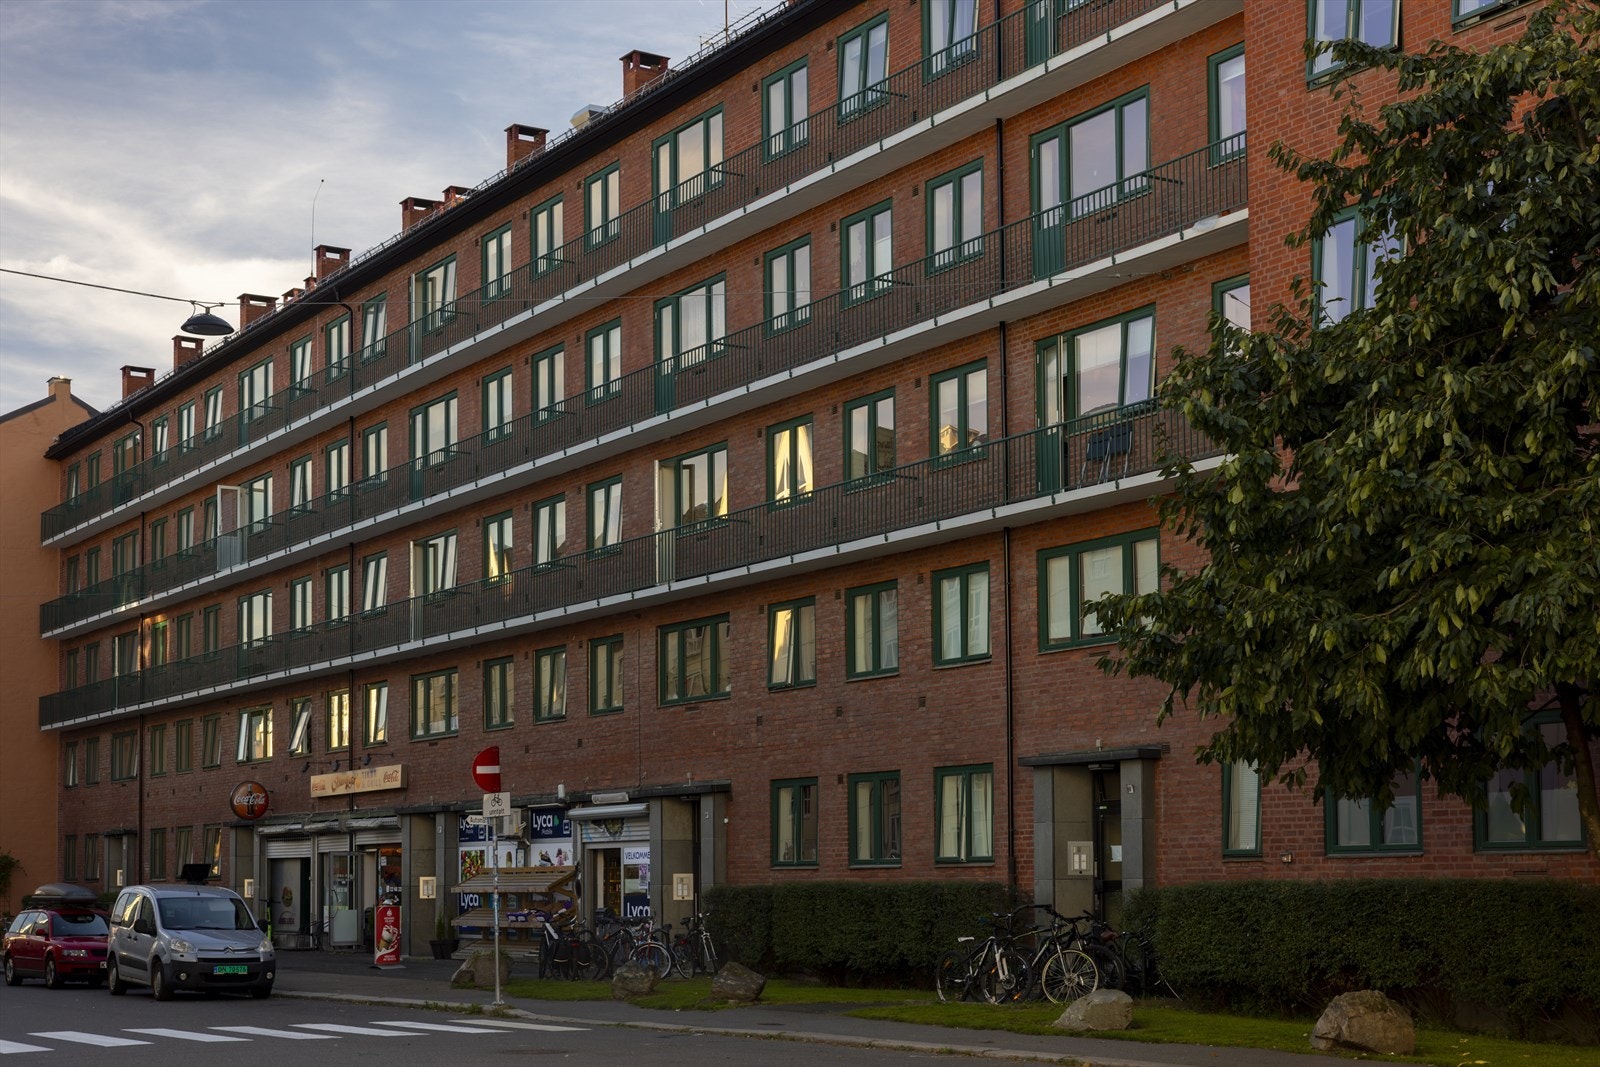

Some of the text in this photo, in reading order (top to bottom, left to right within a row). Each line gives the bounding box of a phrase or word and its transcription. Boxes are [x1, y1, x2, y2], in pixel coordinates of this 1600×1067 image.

[489, 808, 505, 816] unntatt
[532, 812, 553, 831] Lyca
[460, 892, 479, 910] Lyca
